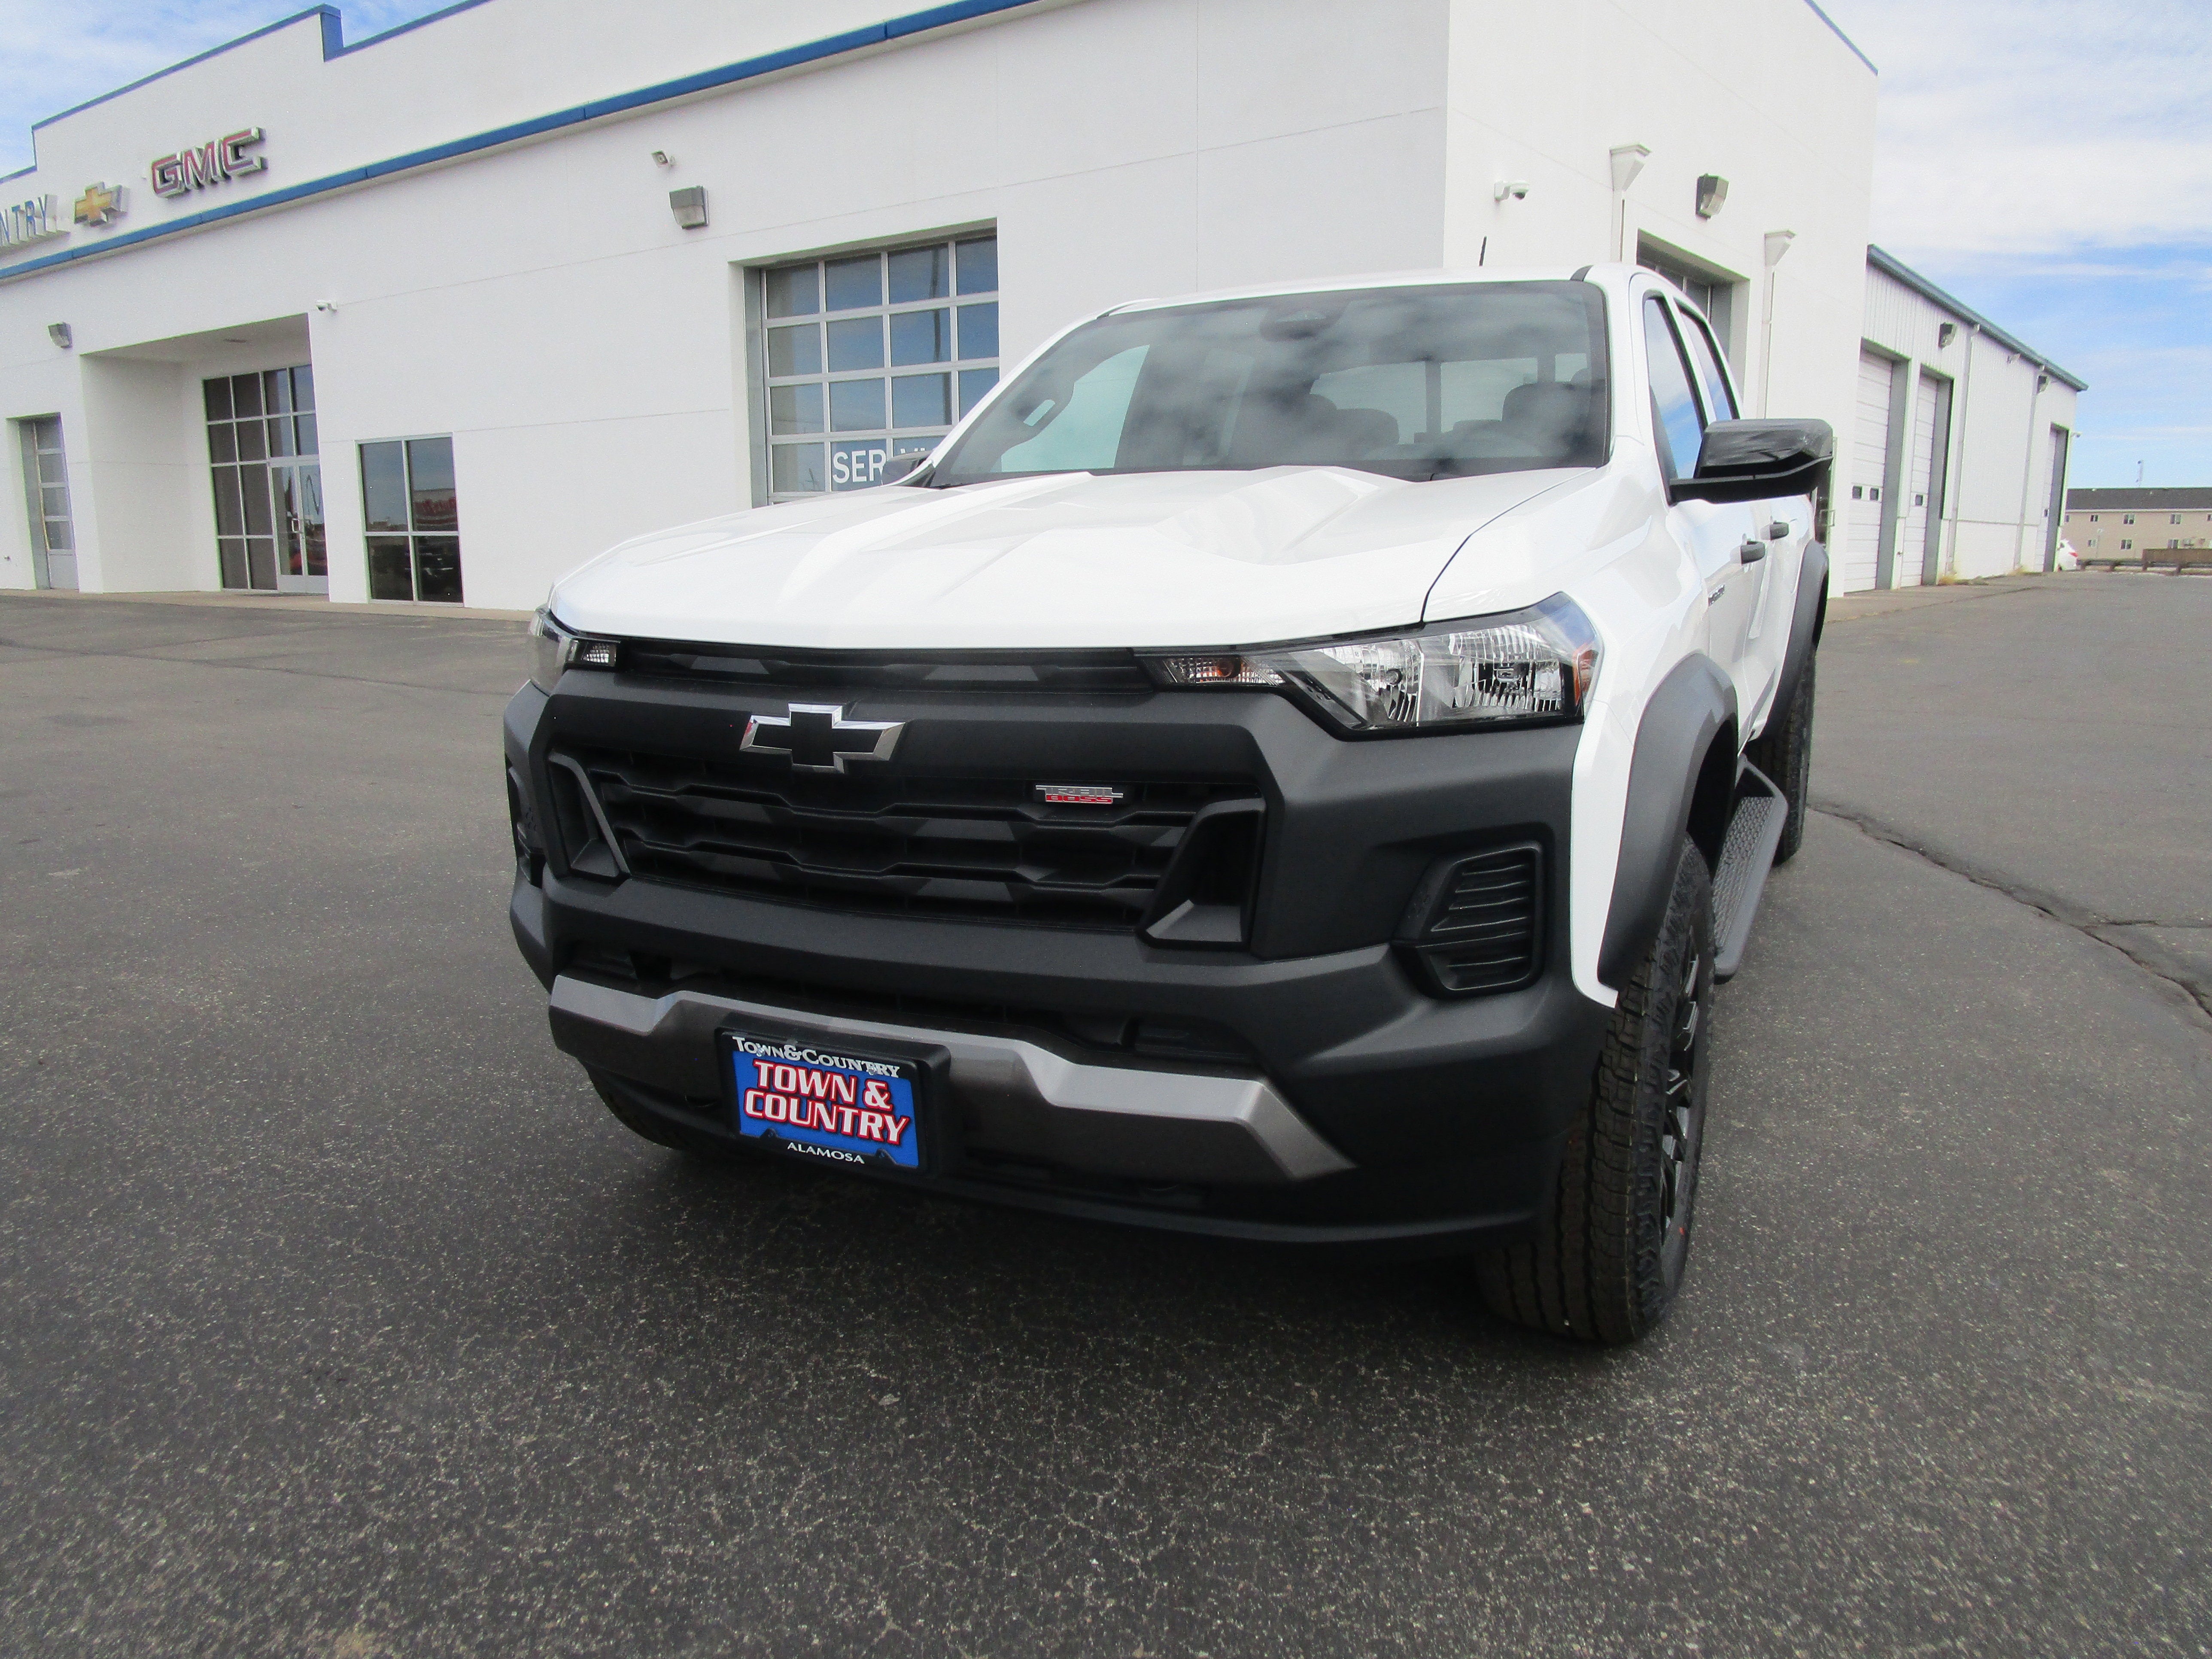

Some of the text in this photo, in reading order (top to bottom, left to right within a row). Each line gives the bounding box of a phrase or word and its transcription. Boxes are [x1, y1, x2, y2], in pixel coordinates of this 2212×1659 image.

[151, 127, 262, 198] GMC
[1045, 794, 1113, 804] BOSS
[753, 1060, 893, 1111] TOWN &
[744, 1088, 910, 1145] COUNTRY
[787, 1142, 865, 1164] ALAMOSA
